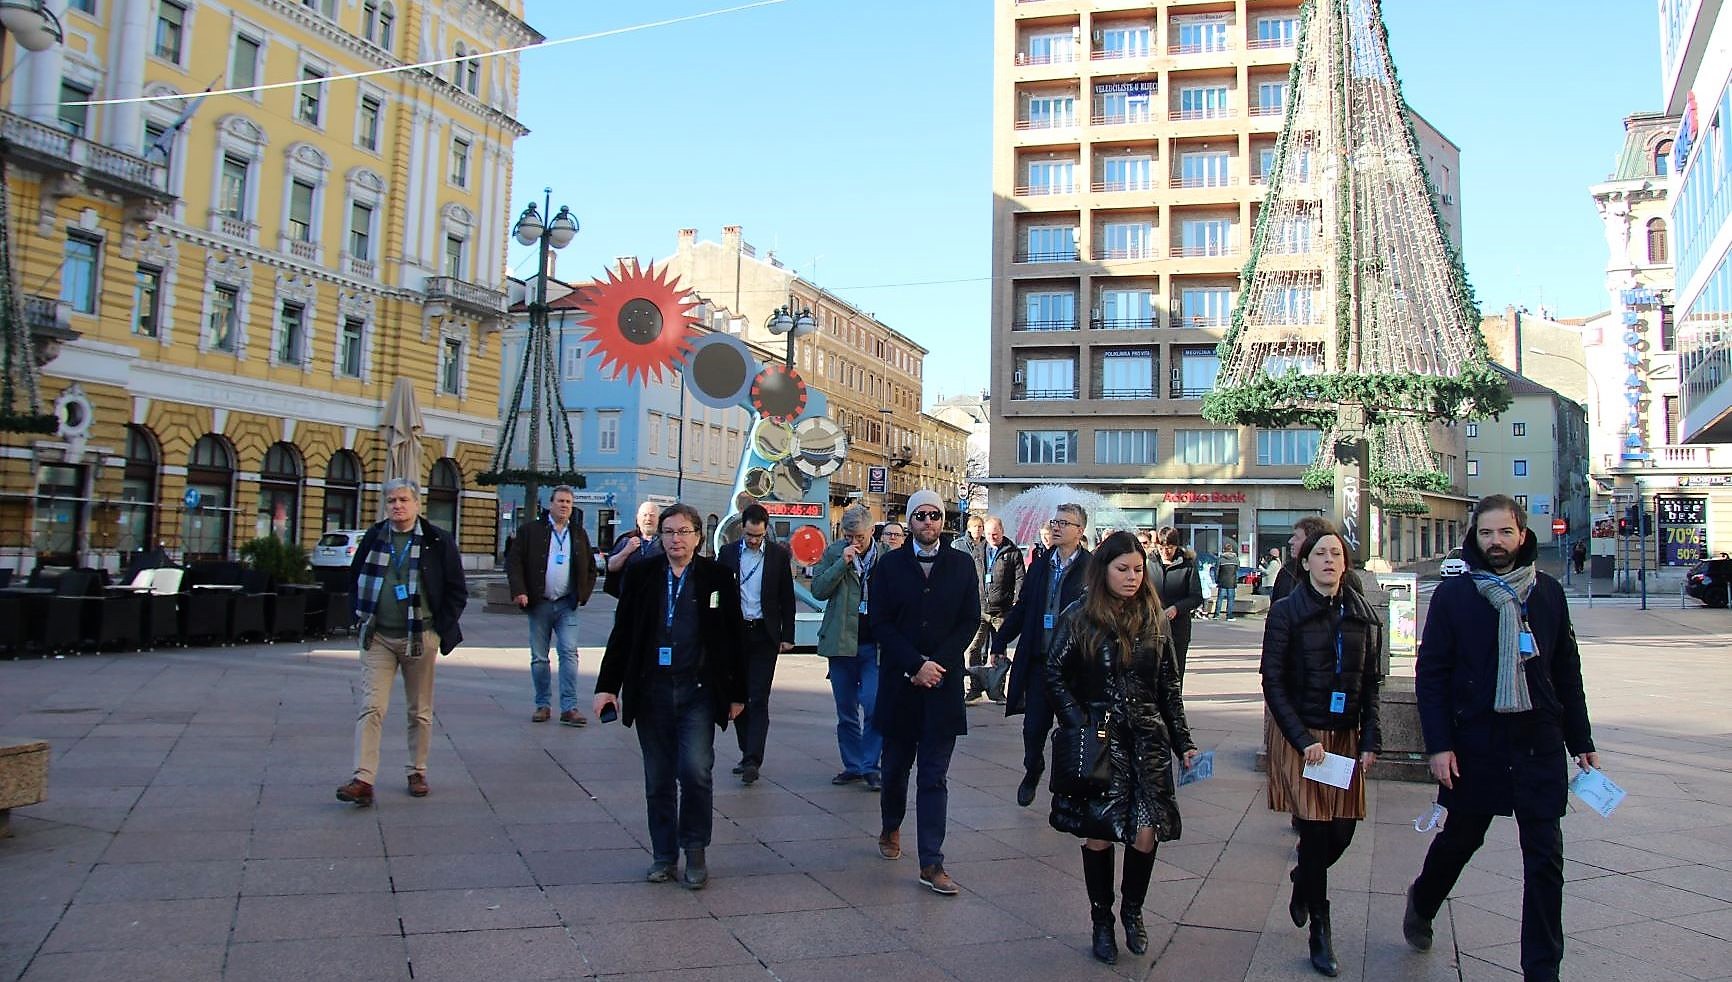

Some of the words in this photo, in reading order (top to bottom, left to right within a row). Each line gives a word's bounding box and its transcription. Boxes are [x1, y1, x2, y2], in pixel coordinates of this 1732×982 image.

[1621, 288, 1658, 305] HOTEL
[1163, 490, 1208, 503] Addiko
[1211, 491, 1246, 503] Bank
[1667, 528, 1700, 544] 70%
[1677, 548, 1700, 560] 50%
